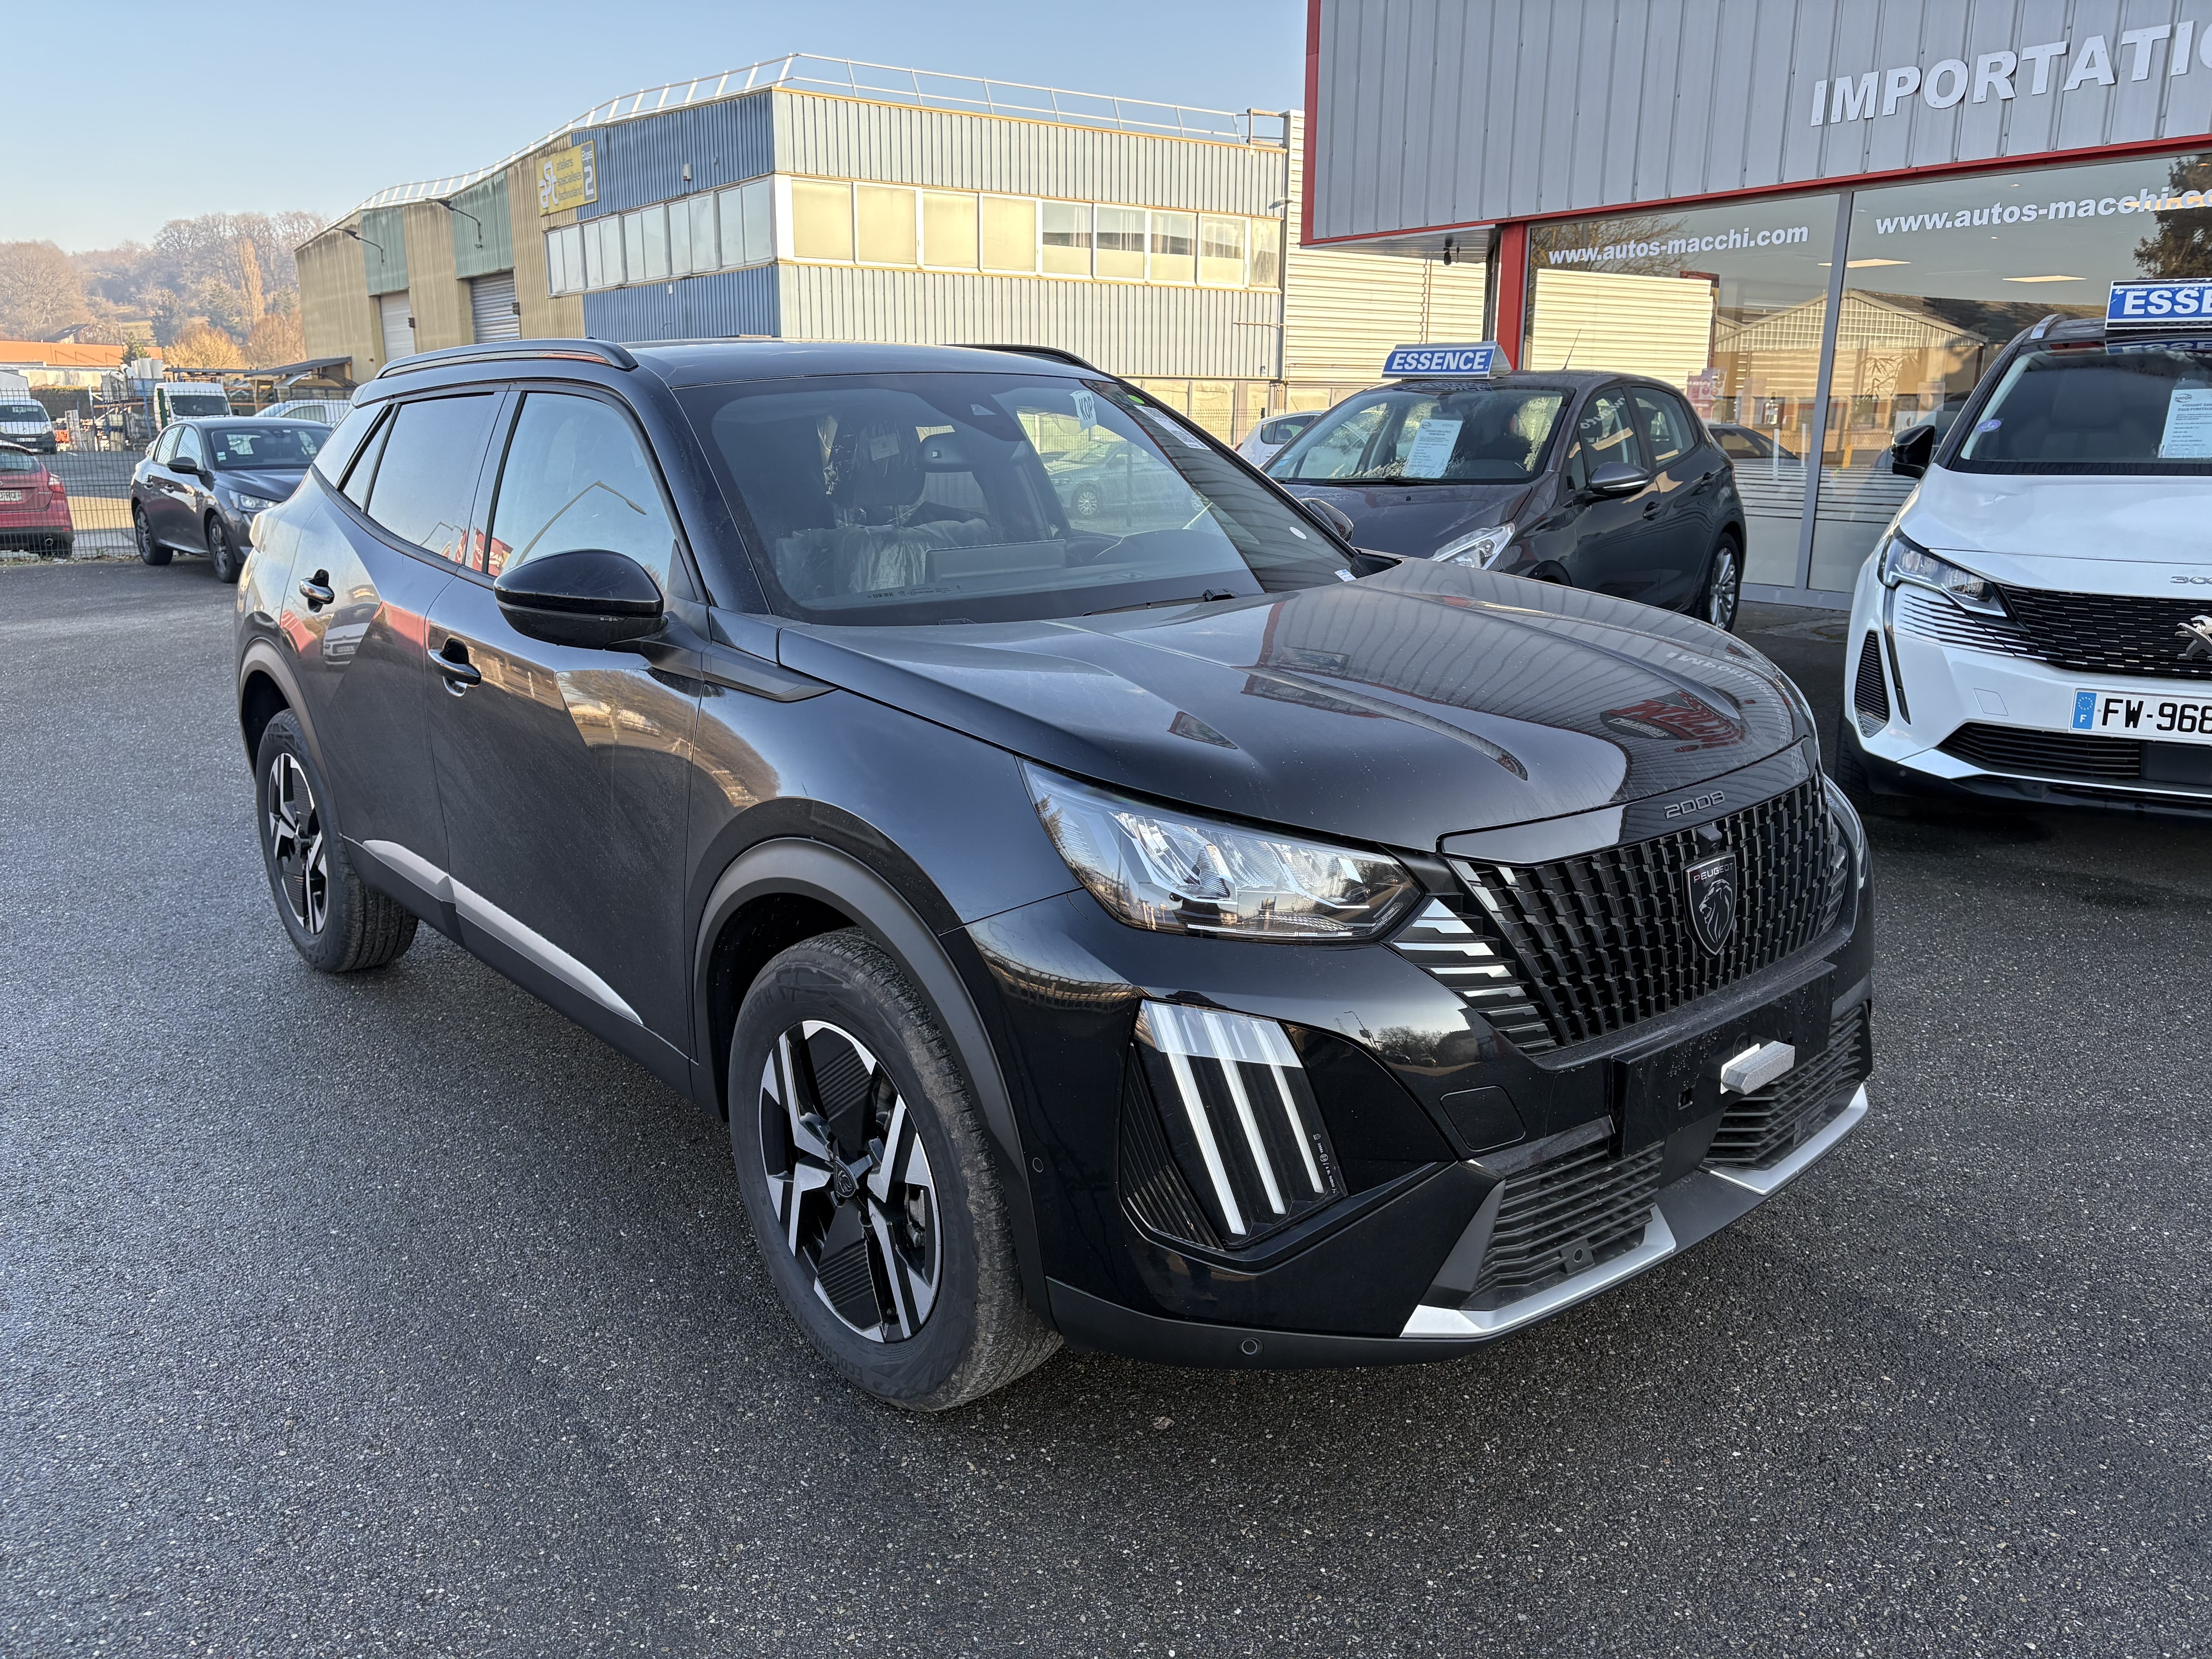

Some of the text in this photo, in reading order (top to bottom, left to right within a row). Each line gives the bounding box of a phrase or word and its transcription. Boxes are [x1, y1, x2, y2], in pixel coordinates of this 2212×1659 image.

[1811, 20, 2212, 127] IMPORTATI
[584, 165, 594, 196] 2
[1549, 226, 1808, 264] www.autos-macchi.com
[1079, 396, 1093, 421] KOP
[2169, 576, 2212, 585] 30
[2080, 714, 2087, 723] F
[2102, 698, 2212, 734] FW-968
[1664, 790, 1725, 819] 2008
[1693, 862, 1733, 883] PEUGEOT
